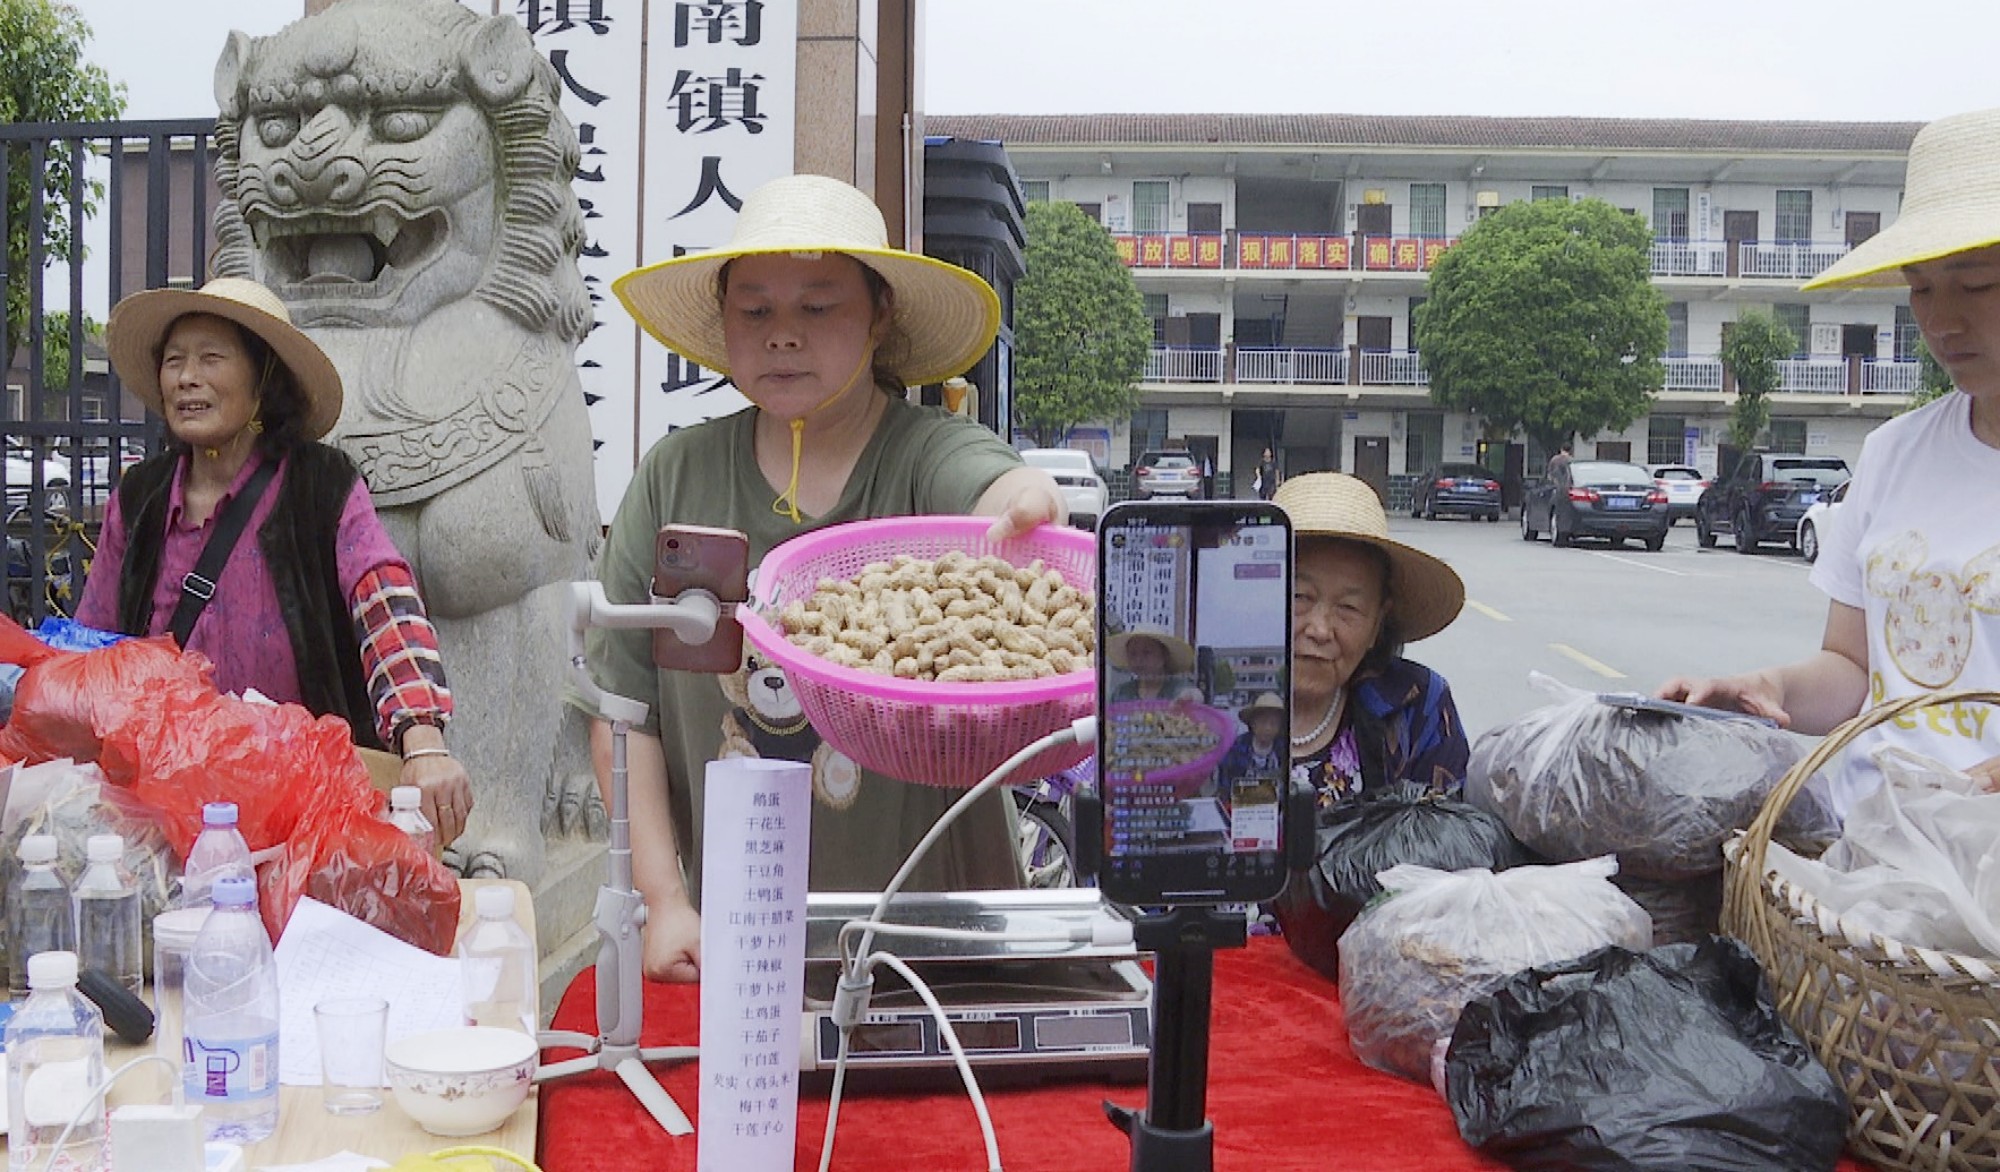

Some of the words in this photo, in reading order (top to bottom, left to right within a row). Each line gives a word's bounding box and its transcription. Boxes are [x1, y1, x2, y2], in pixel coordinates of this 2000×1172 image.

[1116, 238, 1219, 262] 解放思想
[1242, 240, 1347, 264] 狠抓落实
[744, 816, 786, 831] 干花生
[745, 840, 784, 854] 黑芝麻
[744, 863, 784, 878] 干豆角
[743, 887, 783, 902] 土鸭蛋
[735, 933, 786, 950] 干萝卜片
[741, 957, 782, 973] 干辣椒
[734, 980, 786, 997] 干萝卜丝
[741, 1003, 781, 1020] 土鸡蛋
[741, 1027, 780, 1043] 干茄子
[741, 1053, 780, 1067] 干白莲
[739, 1098, 779, 1113] 梅干菜
[734, 1121, 784, 1137] 干莲子心
